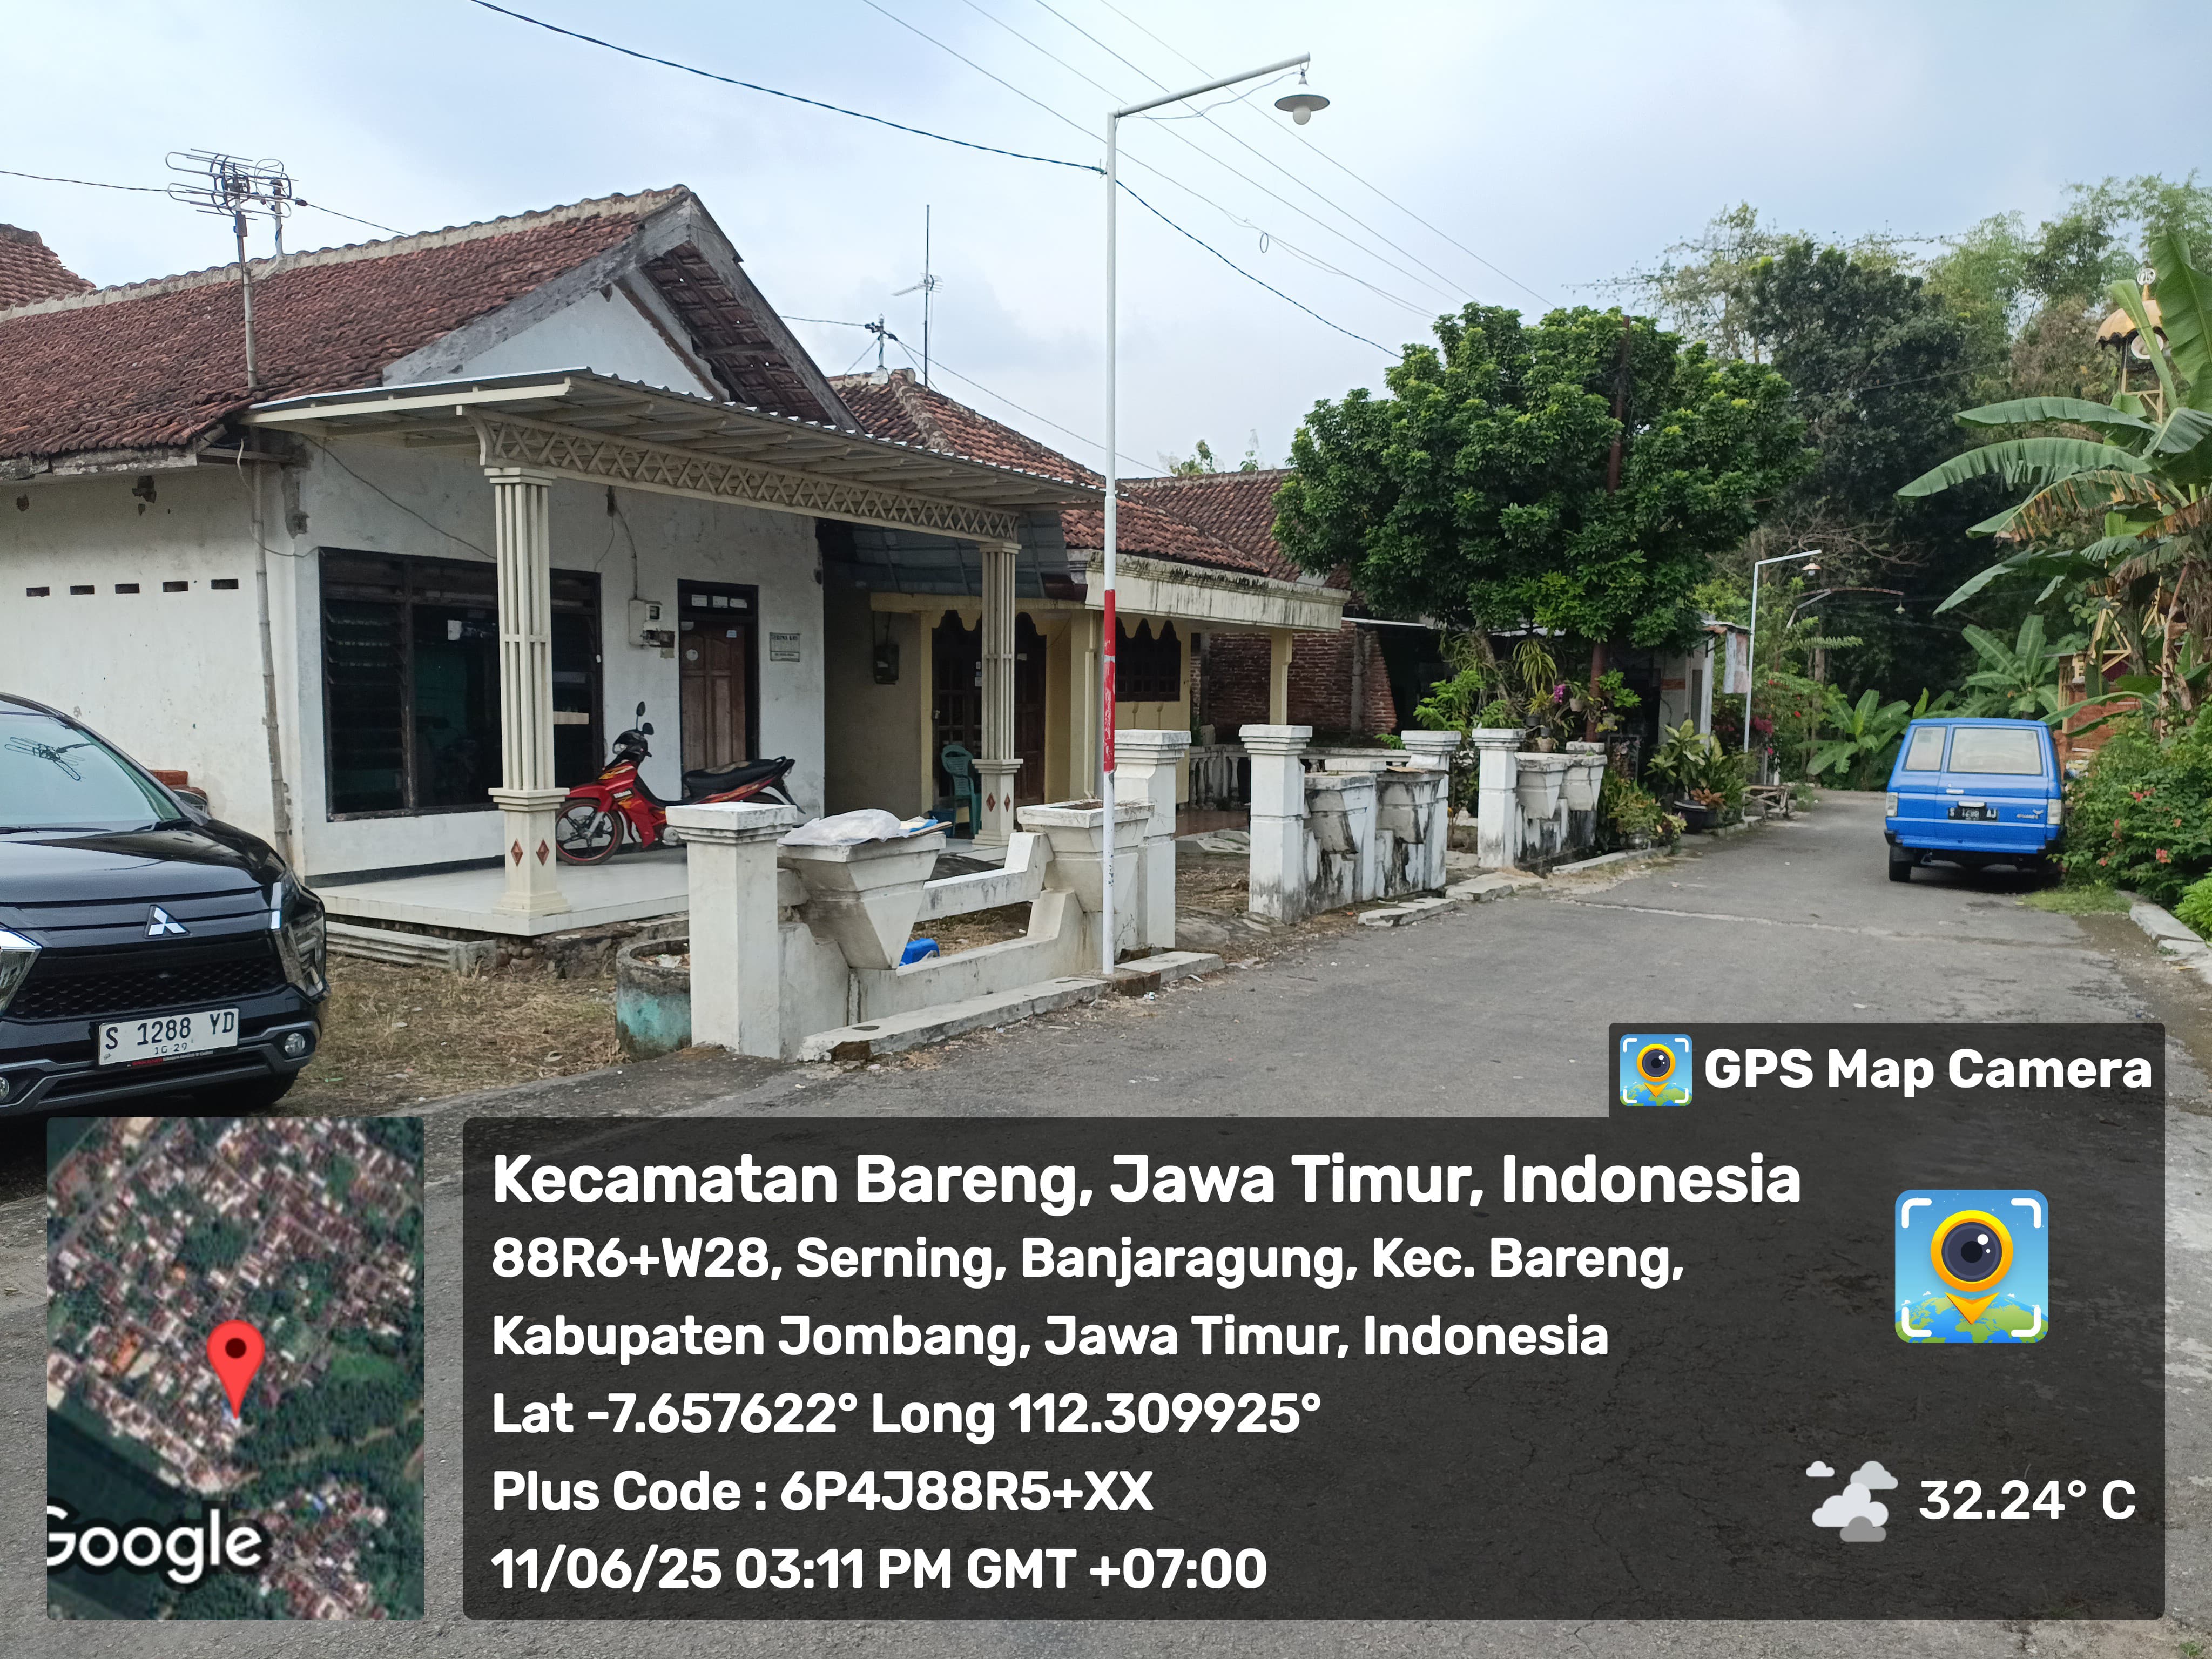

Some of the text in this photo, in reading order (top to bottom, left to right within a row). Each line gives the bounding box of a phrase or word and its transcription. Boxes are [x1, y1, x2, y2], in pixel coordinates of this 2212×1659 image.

[105, 1011, 235, 1050] S 1288 YD
